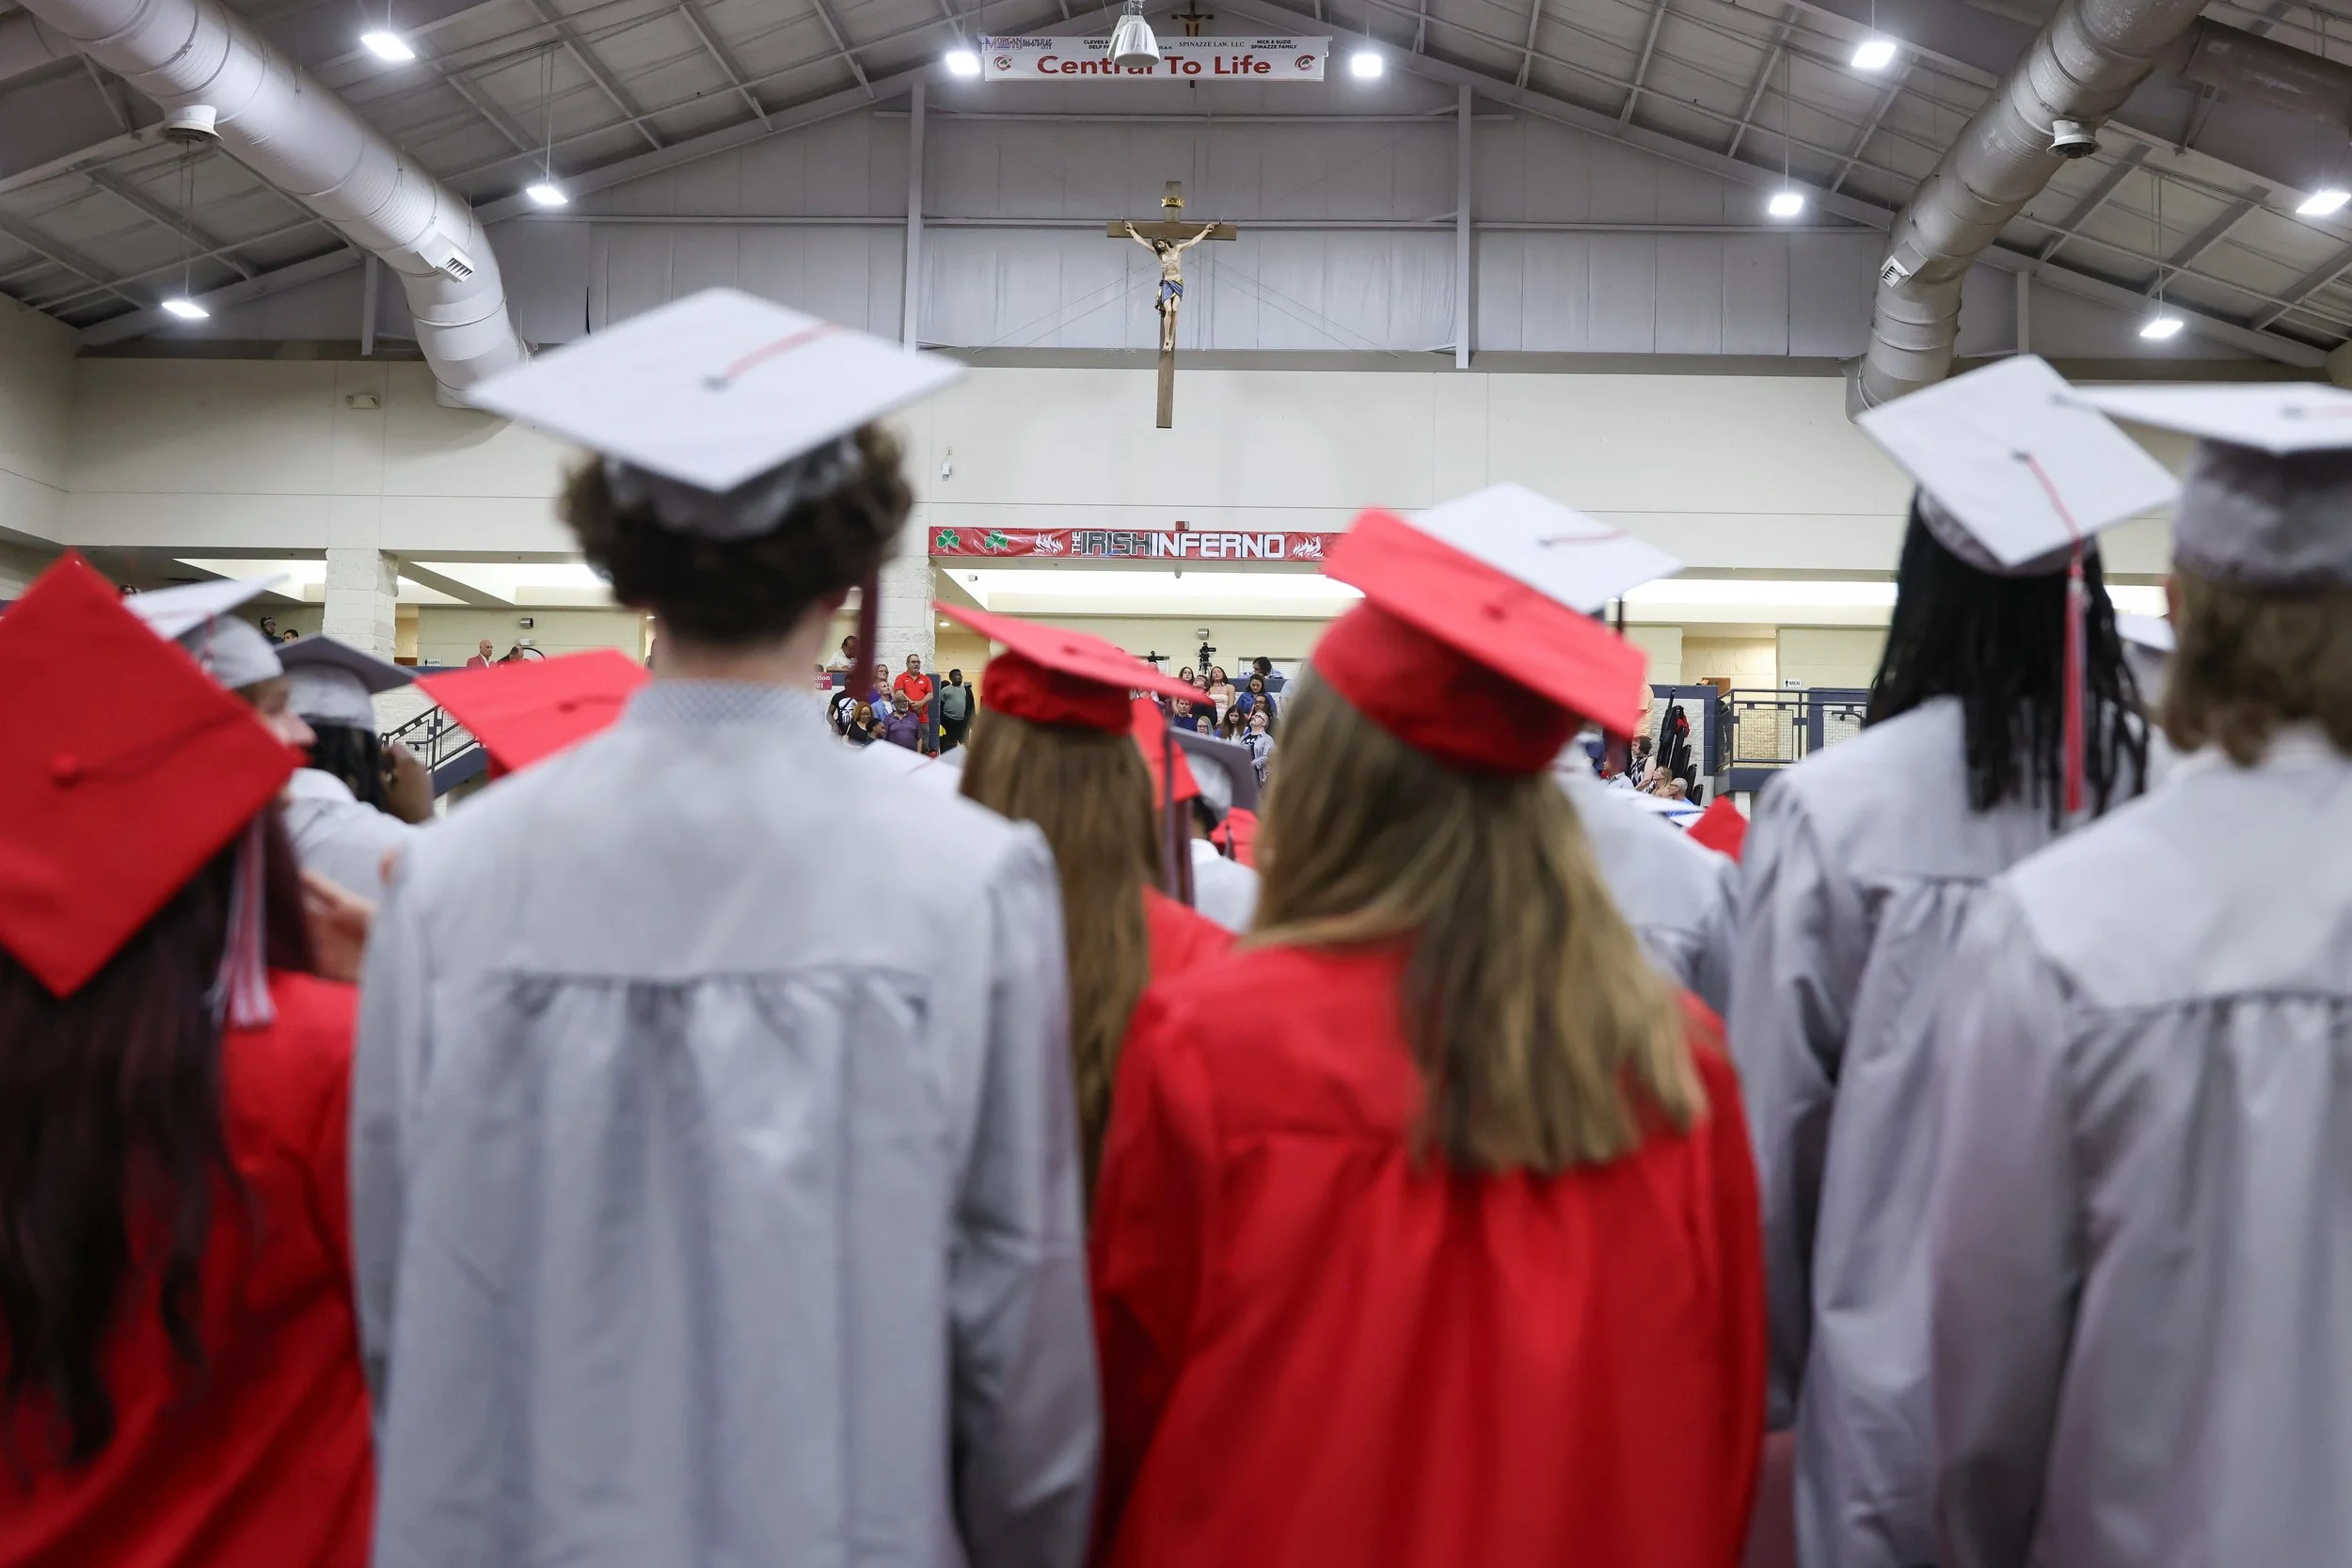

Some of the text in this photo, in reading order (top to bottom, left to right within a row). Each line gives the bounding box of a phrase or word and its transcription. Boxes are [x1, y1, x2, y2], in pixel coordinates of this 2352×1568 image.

[1164, 56, 1201, 75] To
[1215, 55, 1271, 75] Life
[1071, 531, 1286, 559] THE IRISH INFERNO
